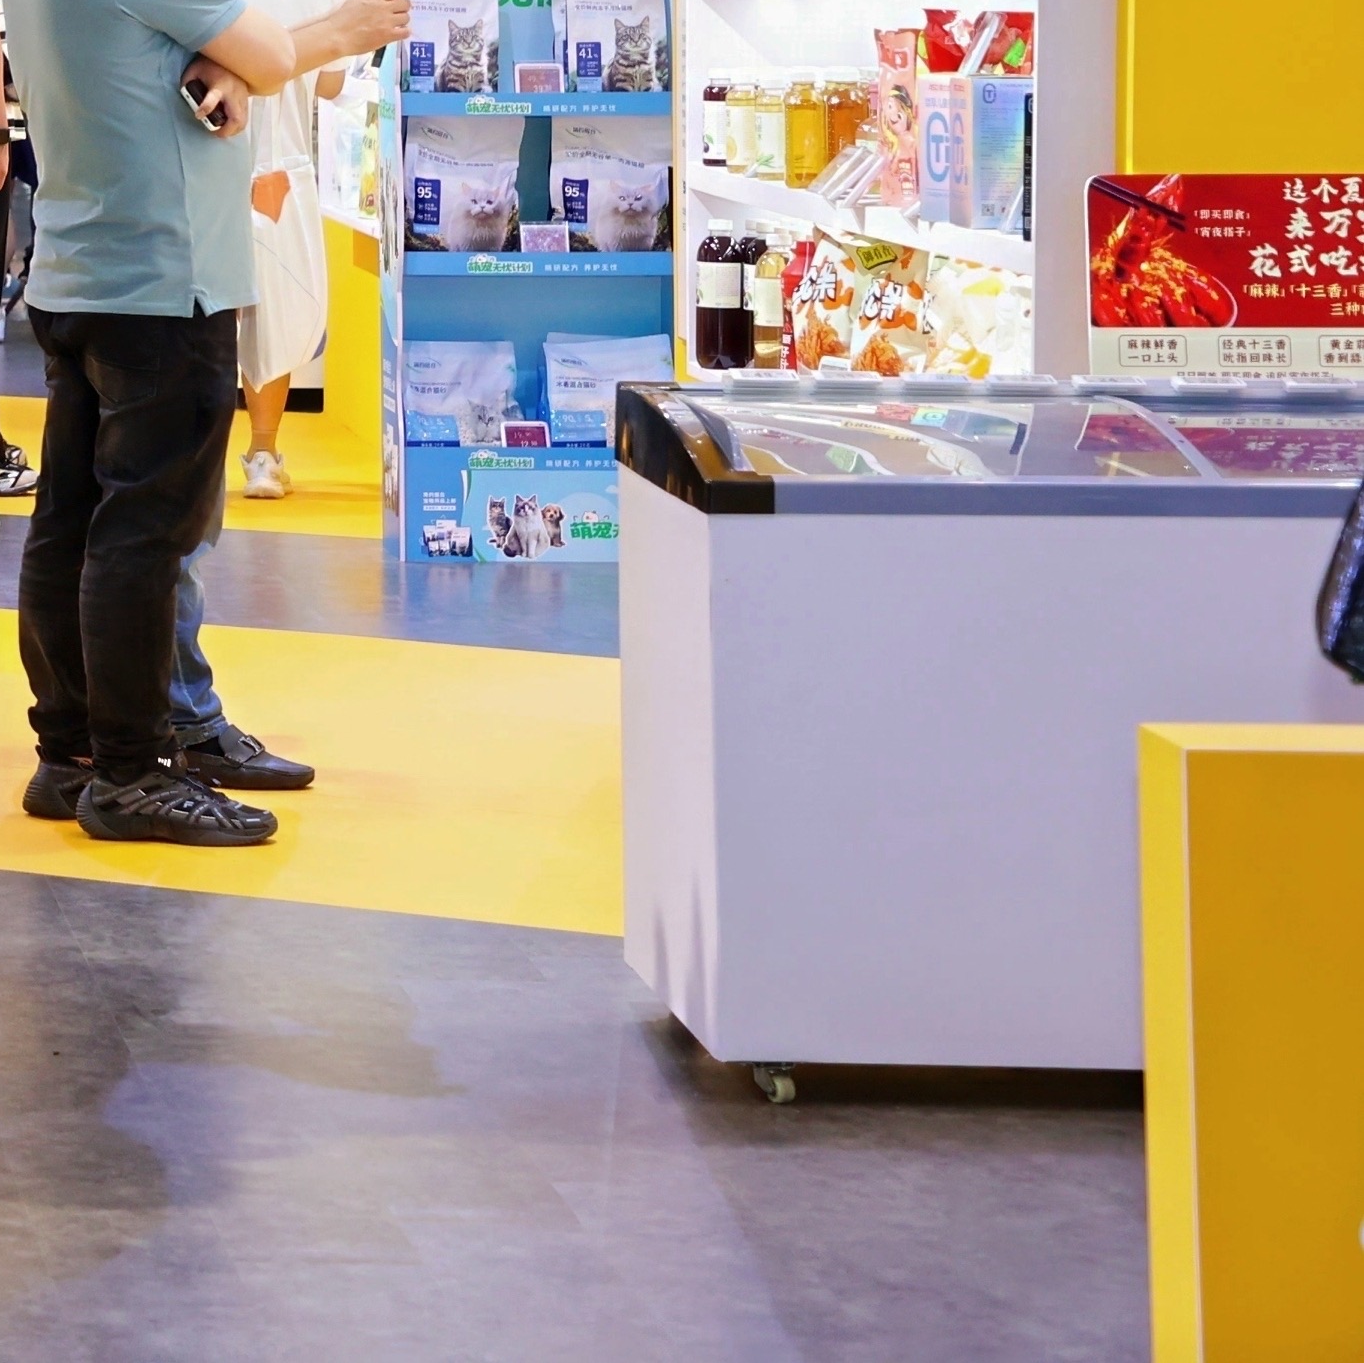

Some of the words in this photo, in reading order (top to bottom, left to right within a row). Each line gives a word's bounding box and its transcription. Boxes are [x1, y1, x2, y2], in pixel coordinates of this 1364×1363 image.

[466, 102, 531, 115] 萌宠无忧计划
[1283, 177, 1364, 205] 这个夏
[1285, 206, 1364, 245] 来万
[1249, 242, 1364, 278] 花式吃
[467, 261, 533, 273] 萌宠无忧计划
[1330, 302, 1364, 317] 三种
[1127, 338, 1179, 351] 麻辣鲜香
[1222, 338, 1287, 351] 经典十三香
[1127, 352, 1179, 364] 一口上头
[1222, 352, 1287, 364] 吮指回味长
[469, 457, 534, 468] 萌宠无忧计划
